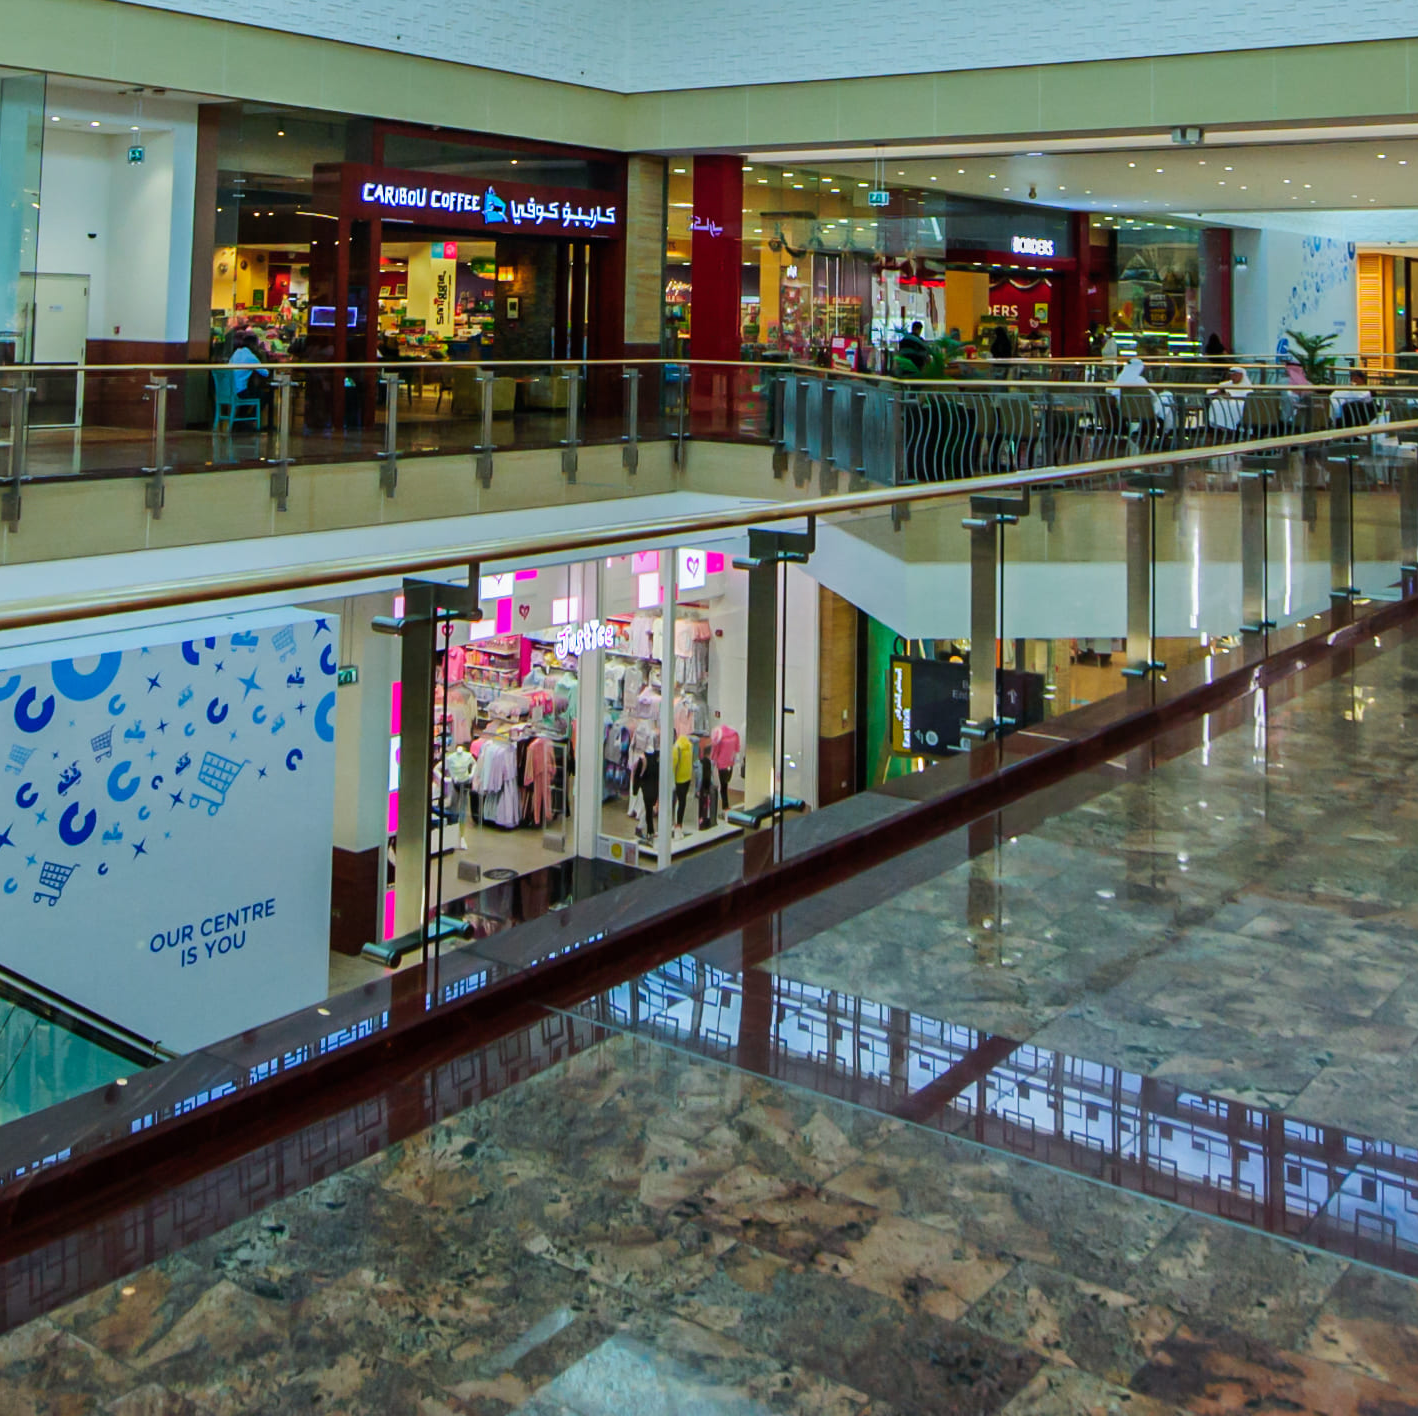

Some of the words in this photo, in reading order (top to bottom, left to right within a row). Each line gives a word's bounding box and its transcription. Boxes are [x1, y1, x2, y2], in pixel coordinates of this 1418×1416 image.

[362, 183, 427, 207] CARIBOU
[430, 190, 481, 212] COFFEE
[149, 924, 194, 953] OUR
[200, 897, 276, 937] CENTRE
[181, 946, 198, 967] IS
[204, 930, 246, 959] YOU
